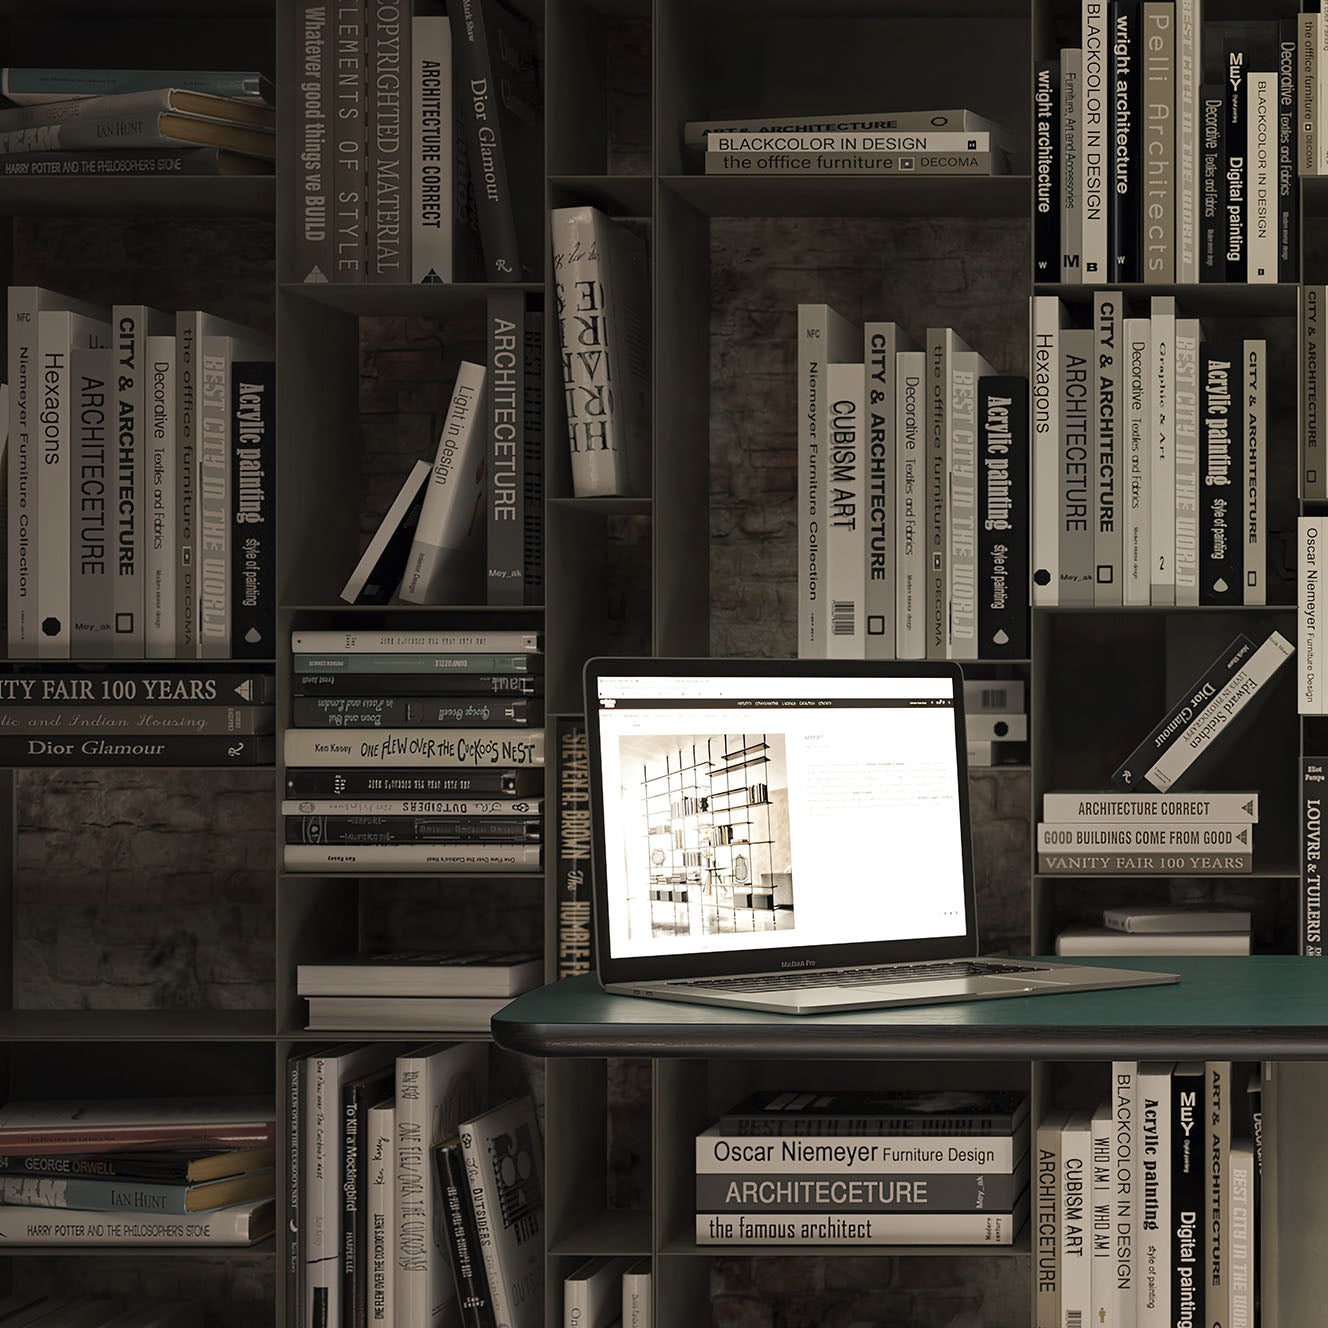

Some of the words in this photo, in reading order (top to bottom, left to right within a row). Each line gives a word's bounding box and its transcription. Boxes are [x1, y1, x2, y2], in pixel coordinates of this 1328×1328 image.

[1148, 14, 1170, 81] Pelli
[422, 60, 441, 162] ARCHITECTURE
[717, 138, 836, 151] BLACKCOLOR
[839, 138, 859, 151] IN
[861, 138, 928, 151] DESIGN
[724, 156, 751, 168] the
[817, 155, 892, 168] furniture
[921, 157, 978, 168] DECOMA
[421, 165, 441, 229] CORRECT
[1147, 103, 1170, 271] Architects
[39, 353, 65, 465] Hexagons
[493, 317, 516, 521] ARCHITECETURE
[832, 400, 856, 482] CUBISM
[832, 488, 856, 531] ART
[41, 679, 96, 701] FAIR
[101, 679, 137, 701] 100
[141, 679, 217, 700] YEARS
[27, 739, 75, 756] Dior
[81, 738, 166, 756] Glamour
[360, 741, 379, 757] ONE
[381, 733, 408, 759] FLEW
[410, 737, 435, 758] OVER
[438, 741, 455, 757] THE
[502, 741, 536, 764] NEST
[1078, 801, 1158, 816] ARCHITECTURE
[1161, 801, 1211, 816] CORRECT
[1044, 830, 1073, 845] GOOD
[1076, 830, 1132, 845] BUILDINGS
[1135, 830, 1166, 845] COME
[1169, 830, 1200, 845] FROM
[1203, 830, 1233, 845] GOOD
[1045, 857, 1111, 869] VANITY
[1115, 857, 1155, 869] FAIR
[1160, 856, 1185, 869] 100
[1189, 857, 1244, 869] YEARS
[714, 1140, 775, 1162] Oscar
[782, 1140, 879, 1167] Niemeyer
[883, 1147, 944, 1162] Furniture
[948, 1147, 995, 1166] Design
[110, 1189, 131, 1207] IAN
[133, 1190, 168, 1211] HUNT
[725, 1181, 928, 1204] ARCHITECETURE
[709, 1216, 733, 1239] the
[738, 1216, 796, 1239] famous
[801, 1216, 872, 1239] architect
[1176, 1211, 1197, 1263] Digital
